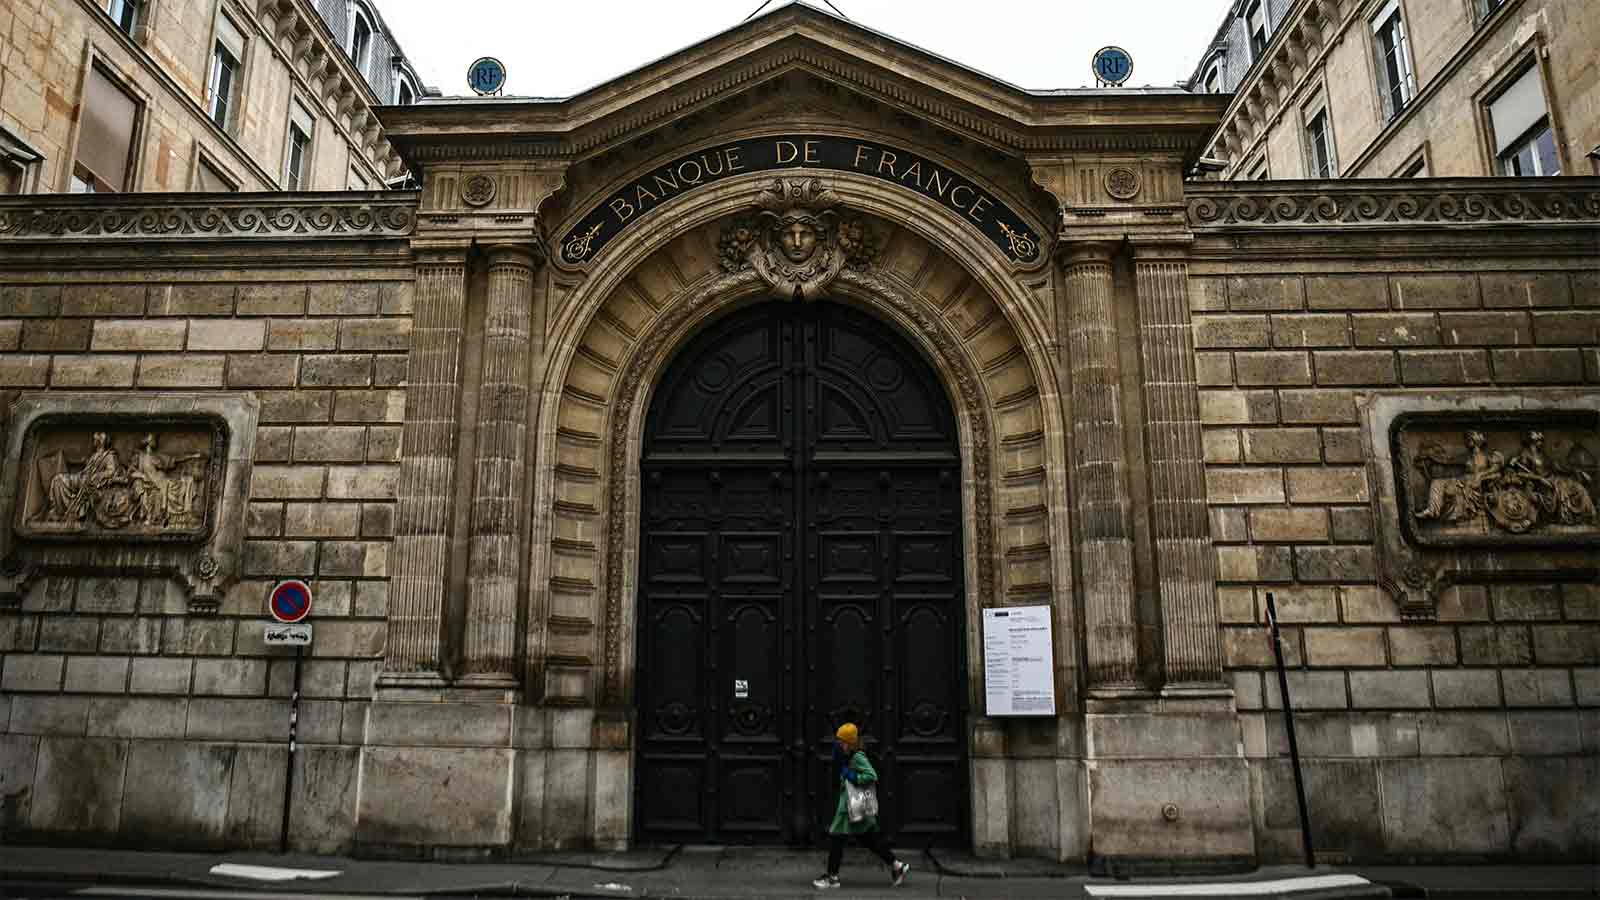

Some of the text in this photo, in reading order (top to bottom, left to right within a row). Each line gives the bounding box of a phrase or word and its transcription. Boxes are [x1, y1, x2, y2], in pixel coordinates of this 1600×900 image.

[1101, 56, 1122, 74] RF
[476, 67, 497, 85] RF
[609, 140, 994, 223] BANQUE DE FRANCE
